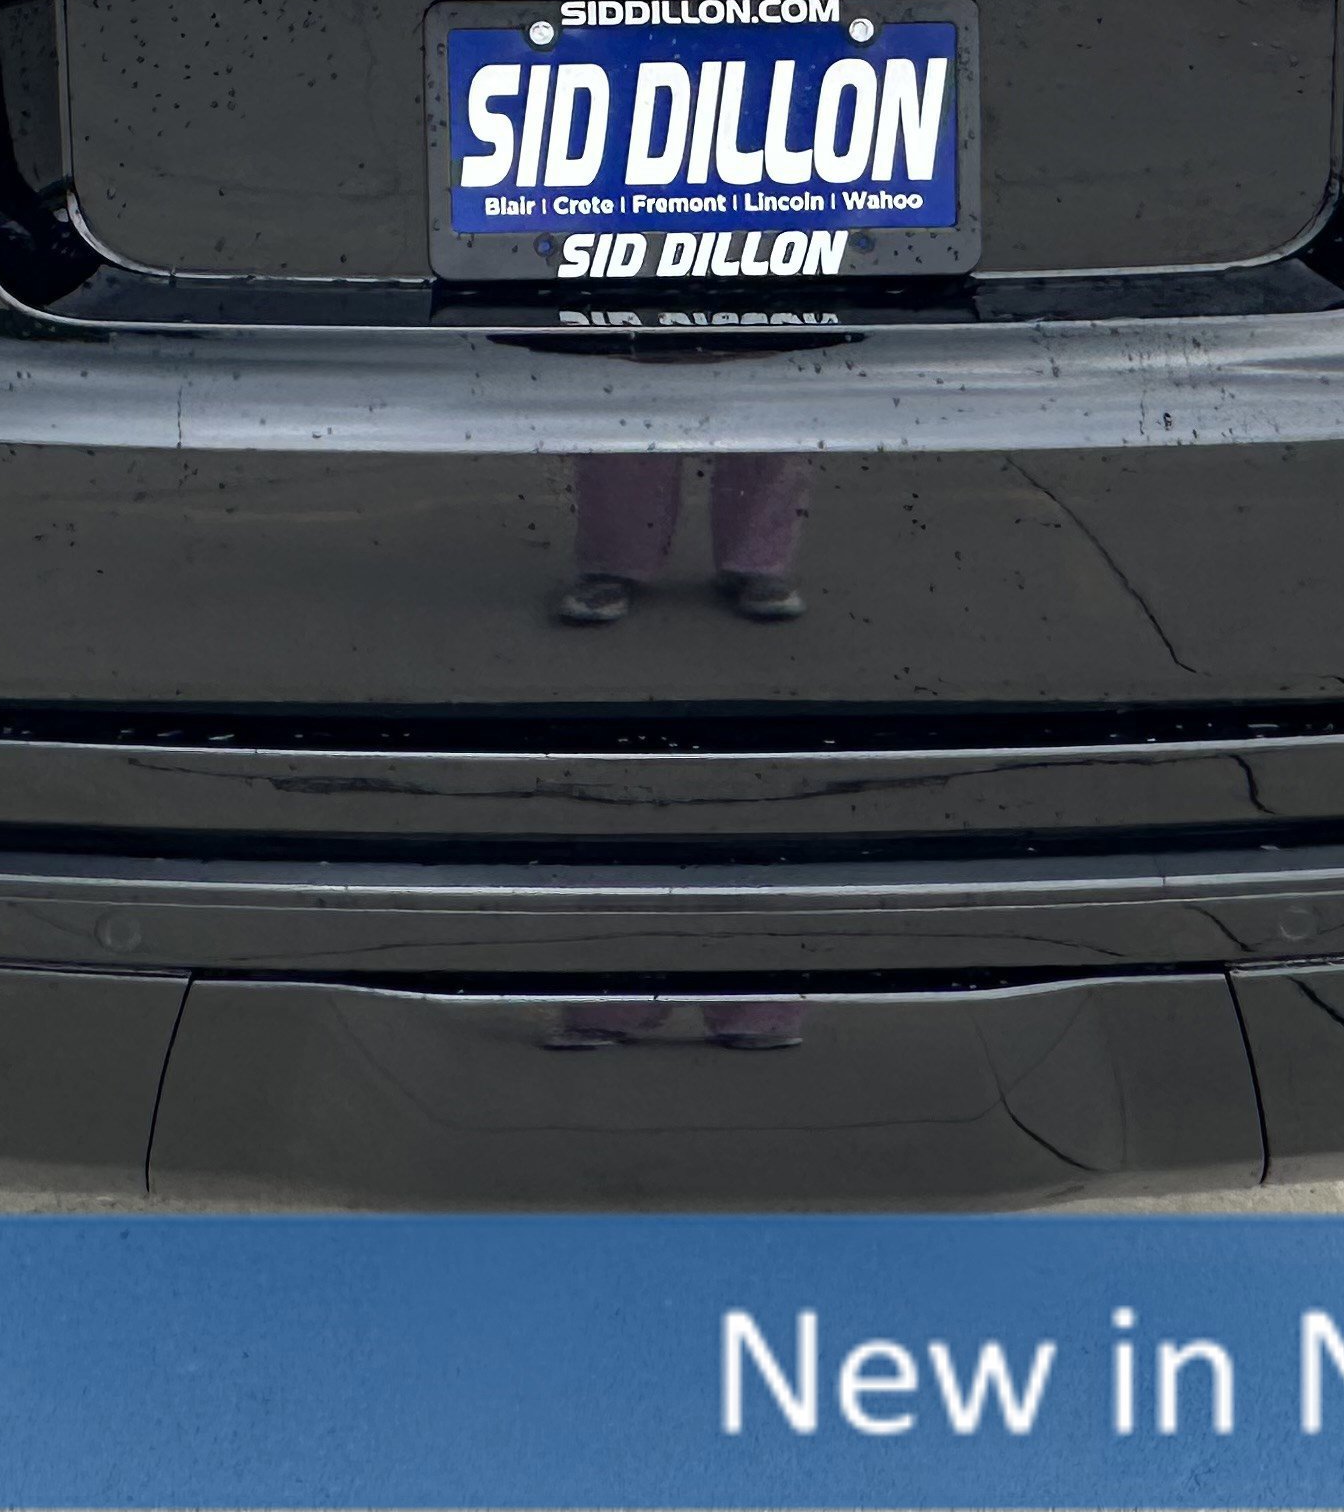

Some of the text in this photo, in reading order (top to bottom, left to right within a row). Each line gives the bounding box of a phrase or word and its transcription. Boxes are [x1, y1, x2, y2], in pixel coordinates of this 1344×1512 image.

[460, 57, 948, 188] SID DILLON
[484, 197, 536, 216] Blair
[632, 194, 727, 214] Fremont
[744, 192, 825, 212] Lincoln
[841, 191, 924, 211] Wahoo
[558, 230, 849, 278] SID DILLON
